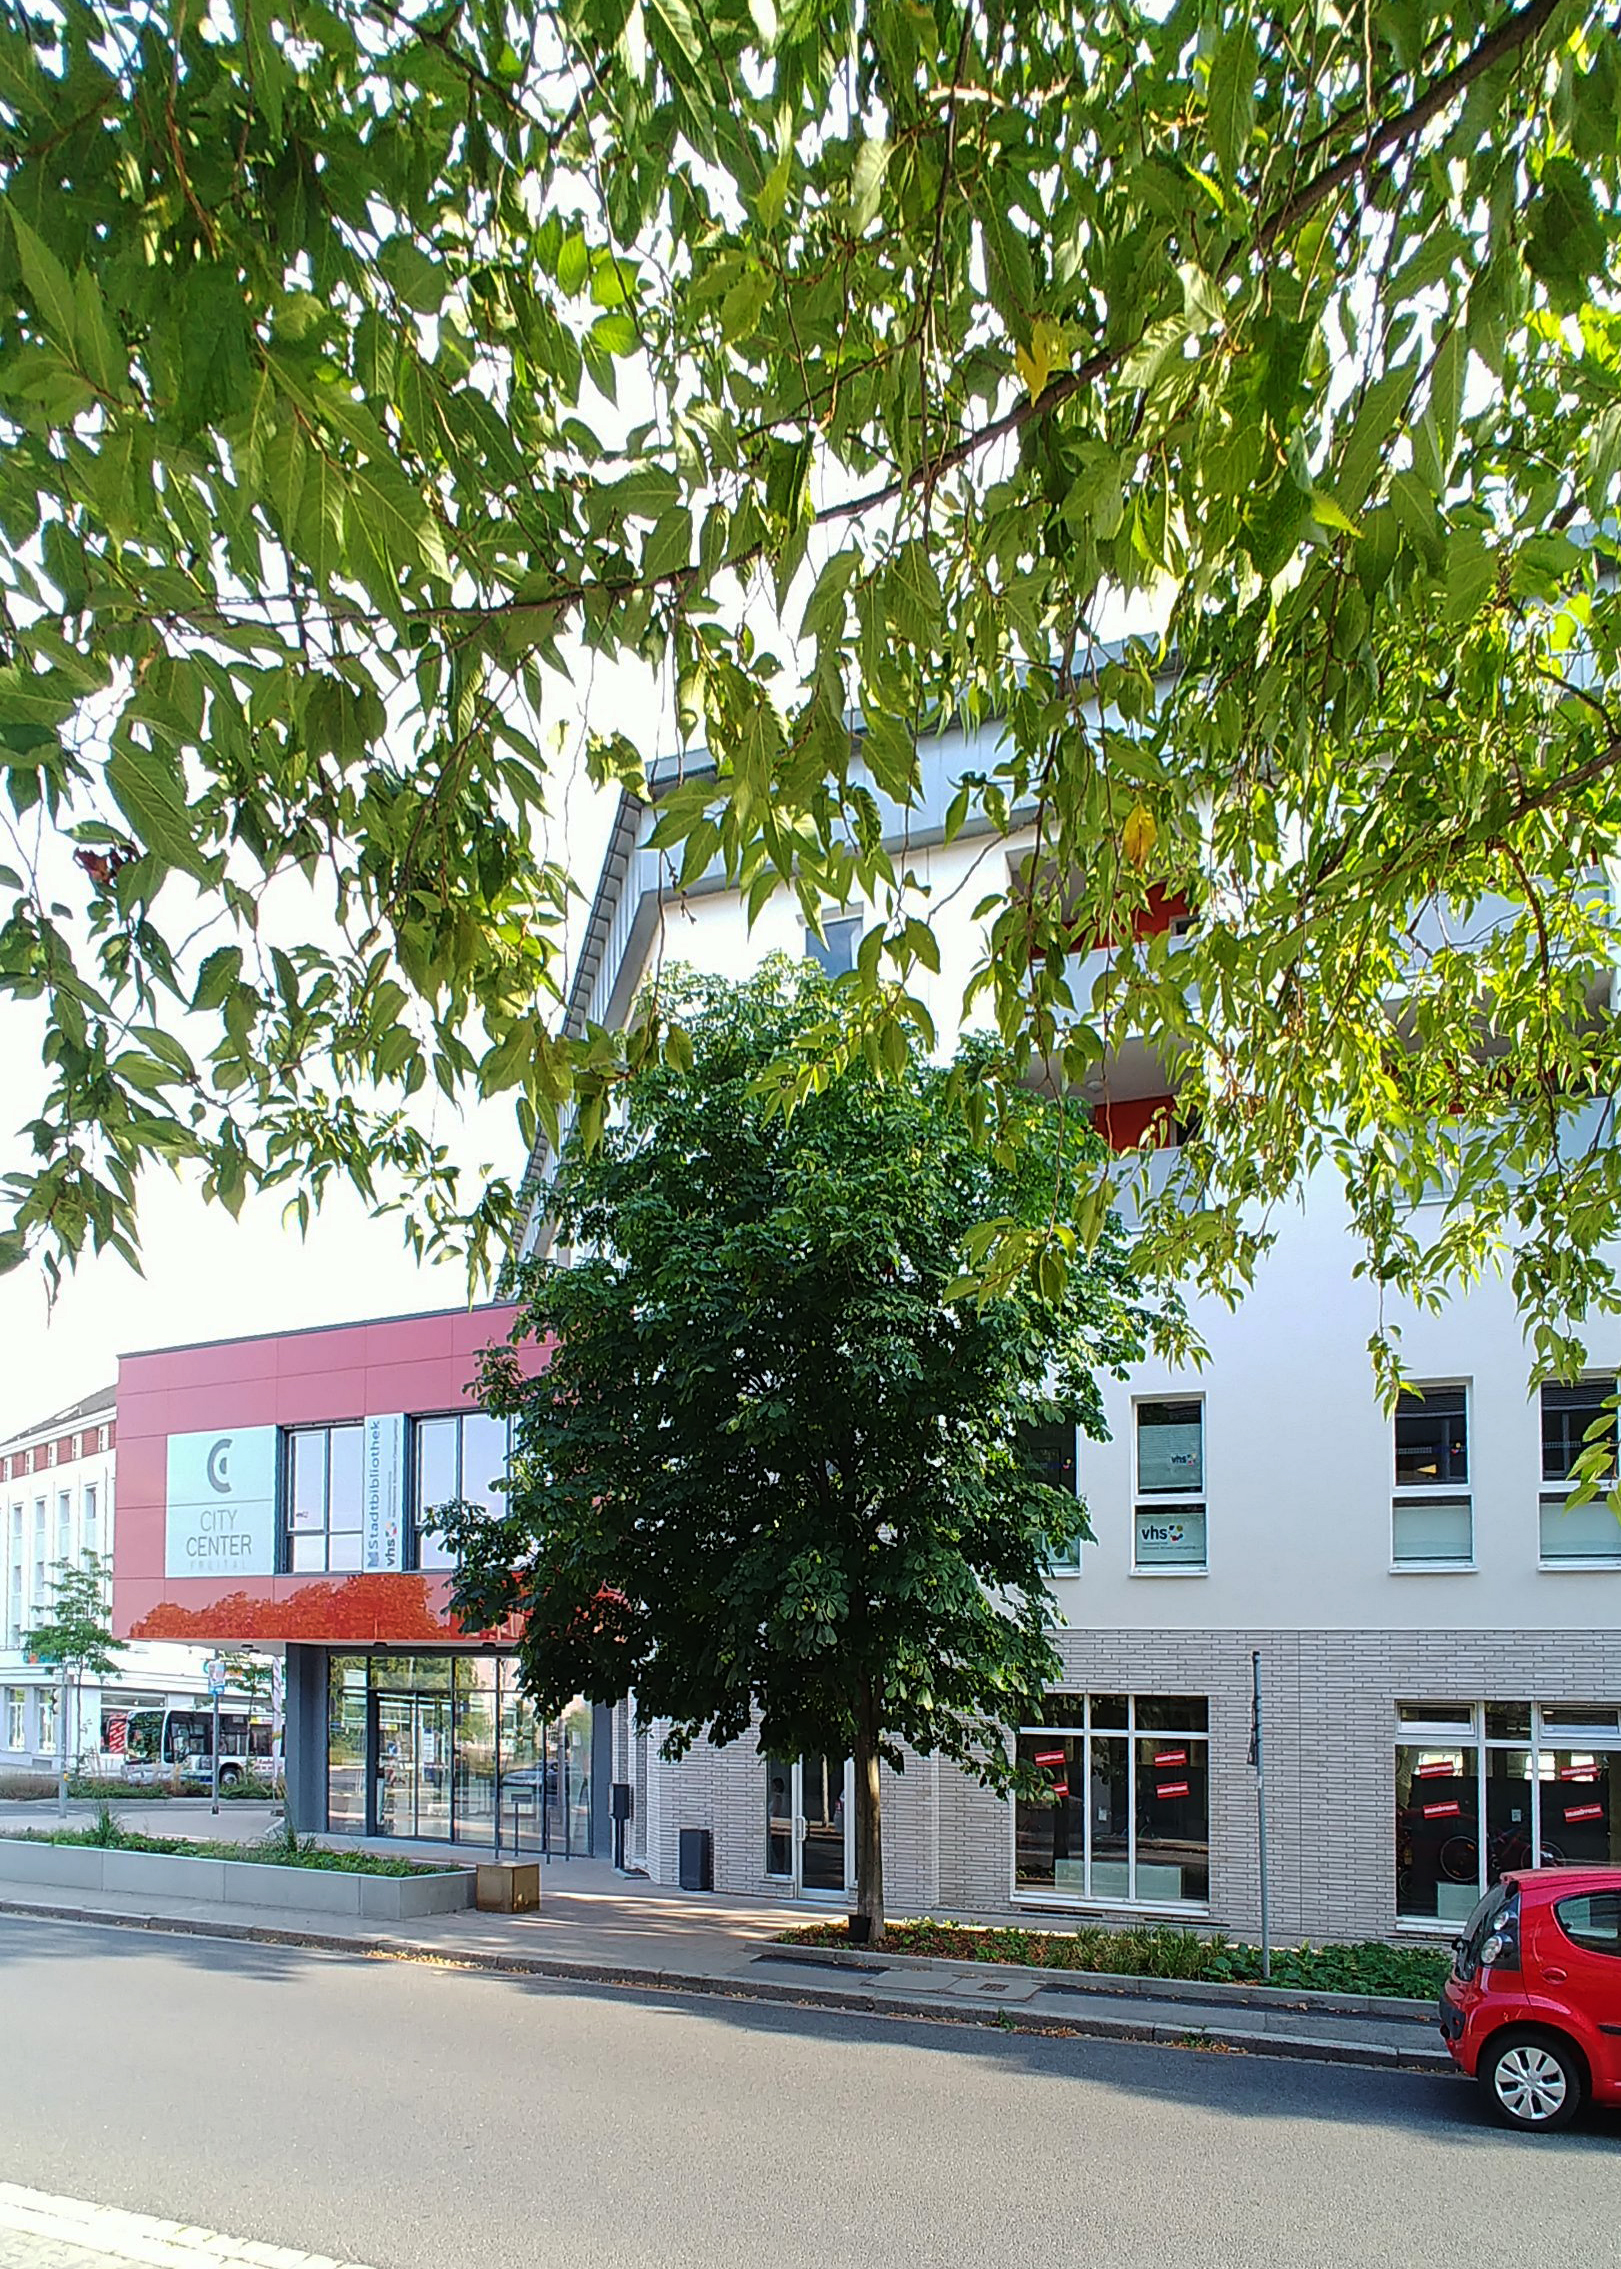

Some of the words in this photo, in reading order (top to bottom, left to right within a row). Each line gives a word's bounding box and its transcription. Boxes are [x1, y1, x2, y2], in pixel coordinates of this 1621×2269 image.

[368, 1420, 380, 1549] Stadtbibliothek
[200, 1509, 238, 1532] CITY
[1141, 1525, 1168, 1540] vhs
[186, 1534, 252, 1556] CENTER
[385, 1538, 396, 1567] vhs
